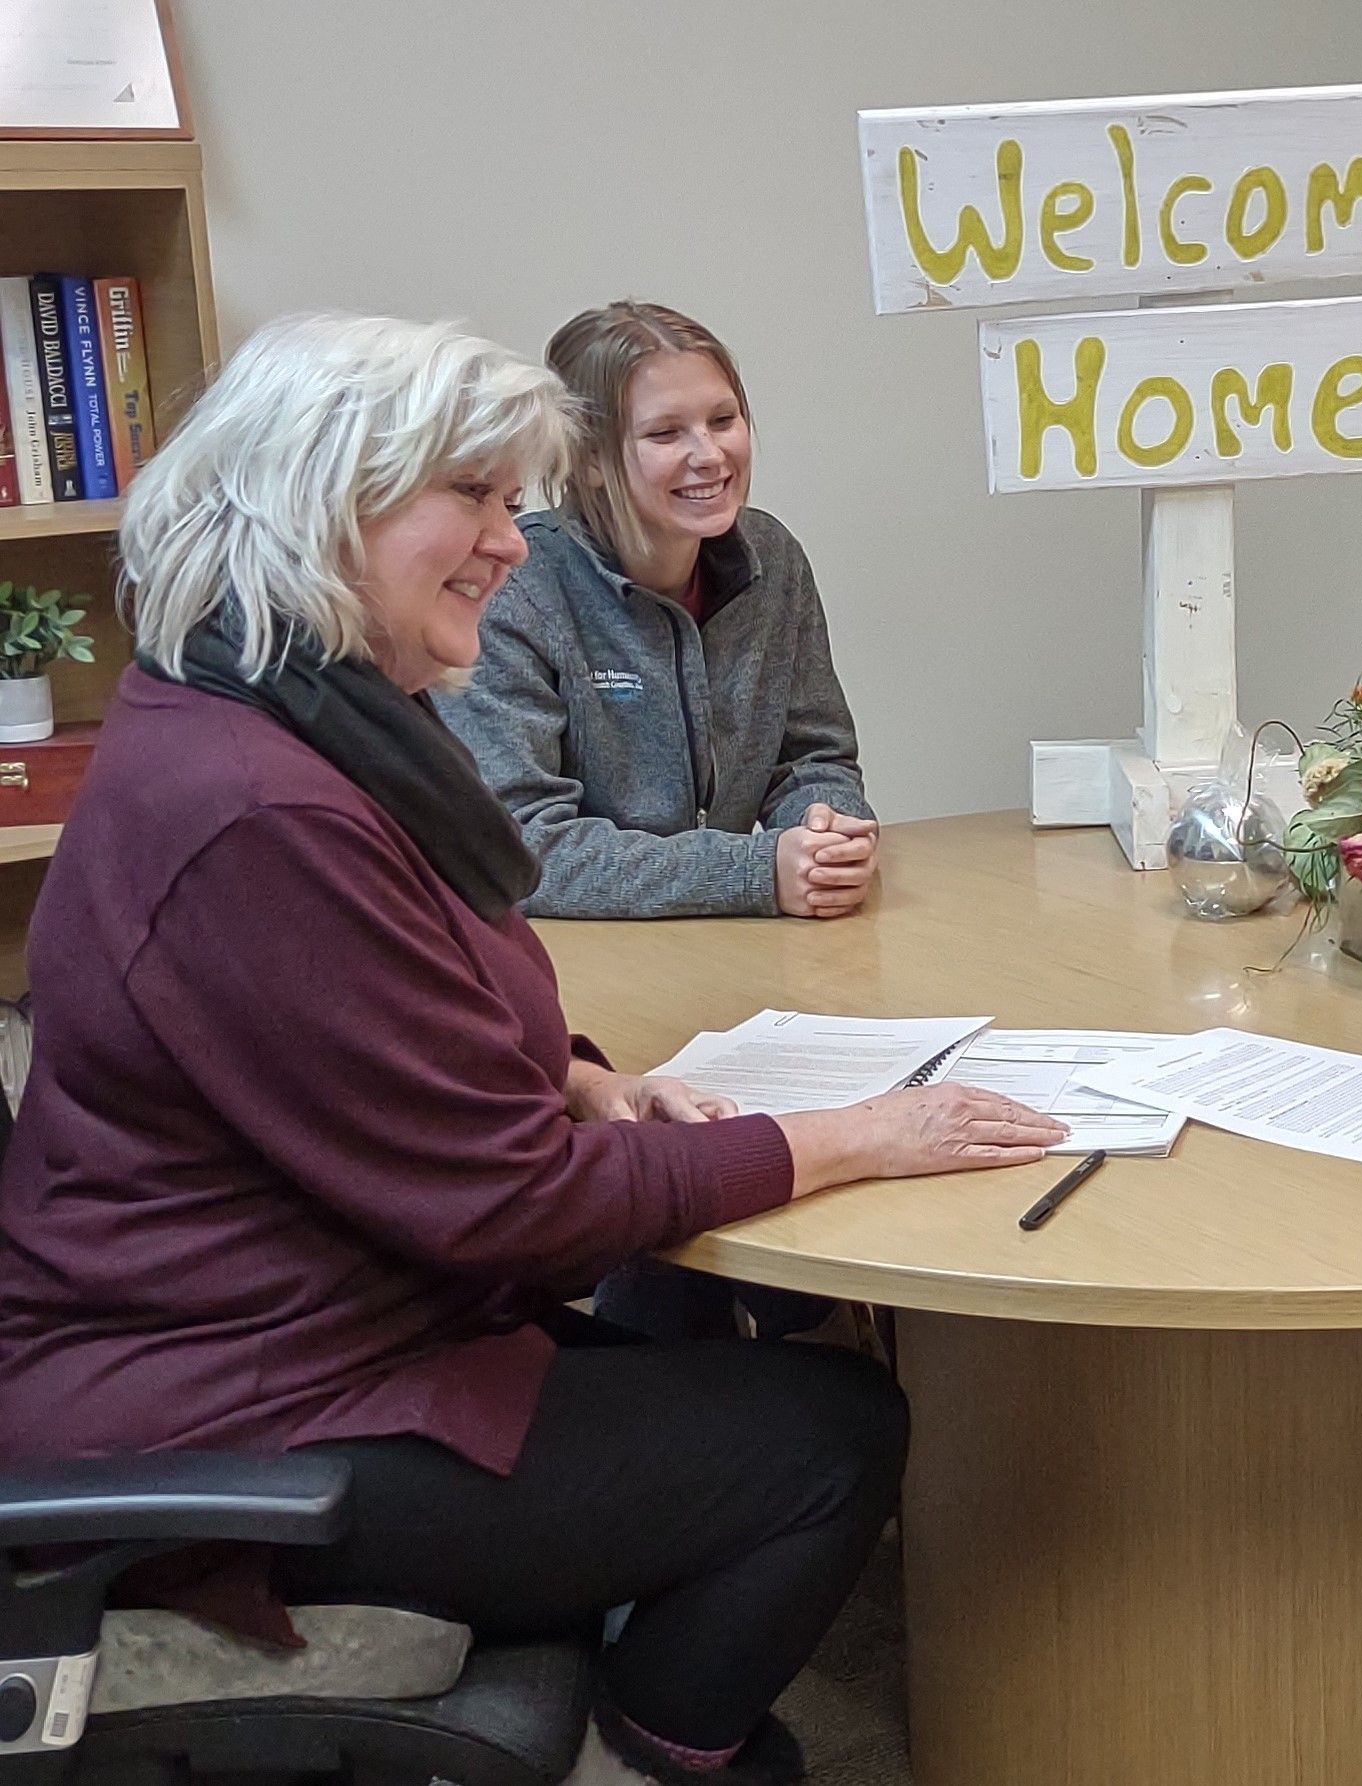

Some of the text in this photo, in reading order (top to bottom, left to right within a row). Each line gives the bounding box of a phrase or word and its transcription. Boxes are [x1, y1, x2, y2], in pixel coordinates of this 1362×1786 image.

[37, 292, 58, 335] DAVID
[74, 286, 91, 334] VINCE
[108, 286, 134, 350] Griffin
[44, 341, 68, 408] BALDACCI
[80, 340, 97, 387] FLYNN
[87, 394, 102, 427] TOTAL
[25, 410, 37, 437] John
[31, 440, 43, 487] Grisham
[93, 428, 105, 467] POWER
